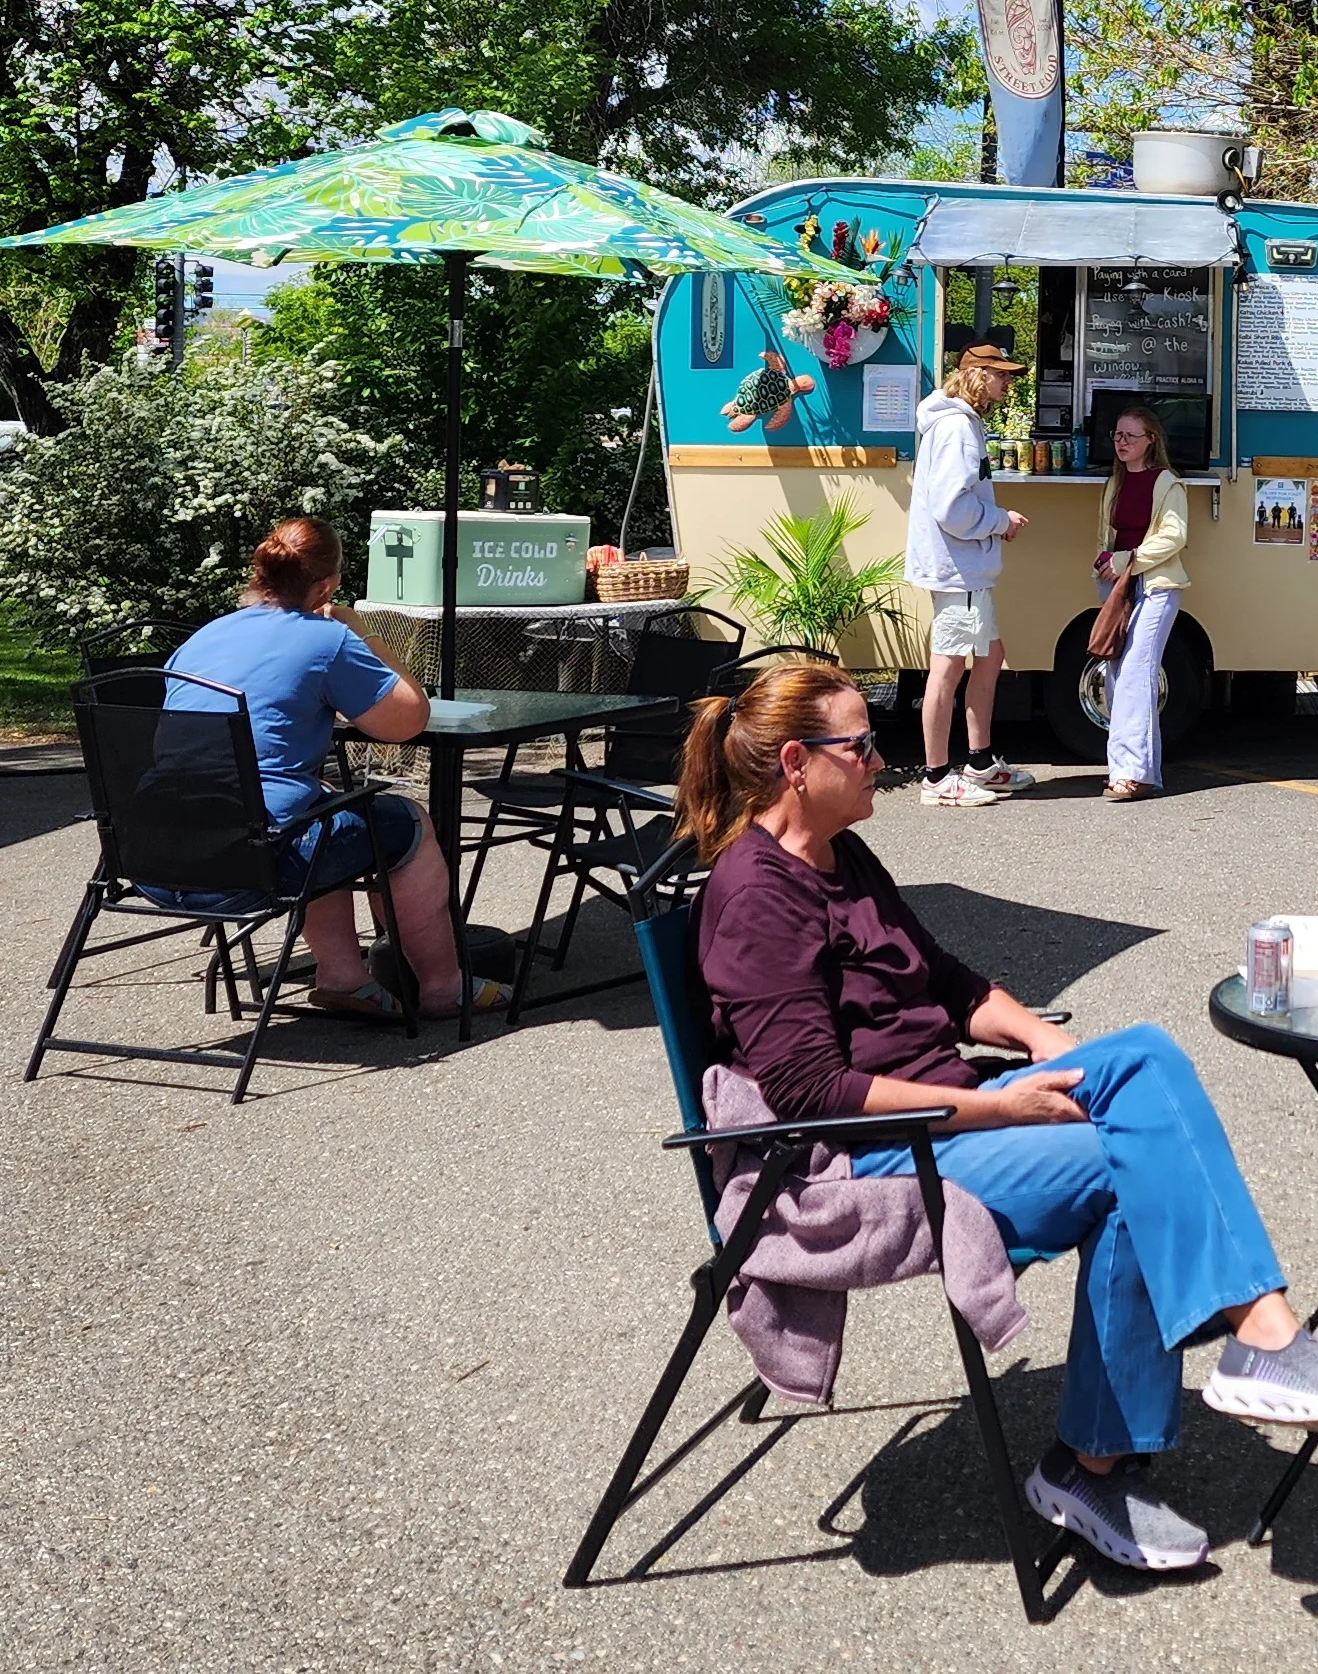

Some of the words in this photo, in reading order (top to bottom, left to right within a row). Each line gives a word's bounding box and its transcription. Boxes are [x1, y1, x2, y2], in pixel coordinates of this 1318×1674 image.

[994, 55, 1037, 92] STREET
[1039, 54, 1058, 90] FOOD
[1091, 266, 1123, 287] Paying
[1127, 269, 1149, 280] with
[1152, 271, 1159, 279] a
[1092, 313, 1123, 337] Paying
[1127, 316, 1151, 329] with
[1157, 312, 1192, 329] cash?
[1141, 336, 1157, 355] @
[1164, 336, 1189, 352] the
[1255, 359, 1271, 367] Pulled
[1272, 359, 1286, 367] Pork
[472, 541, 506, 558] ICE
[510, 541, 558, 559] COLD
[477, 563, 548, 587] Drinks
